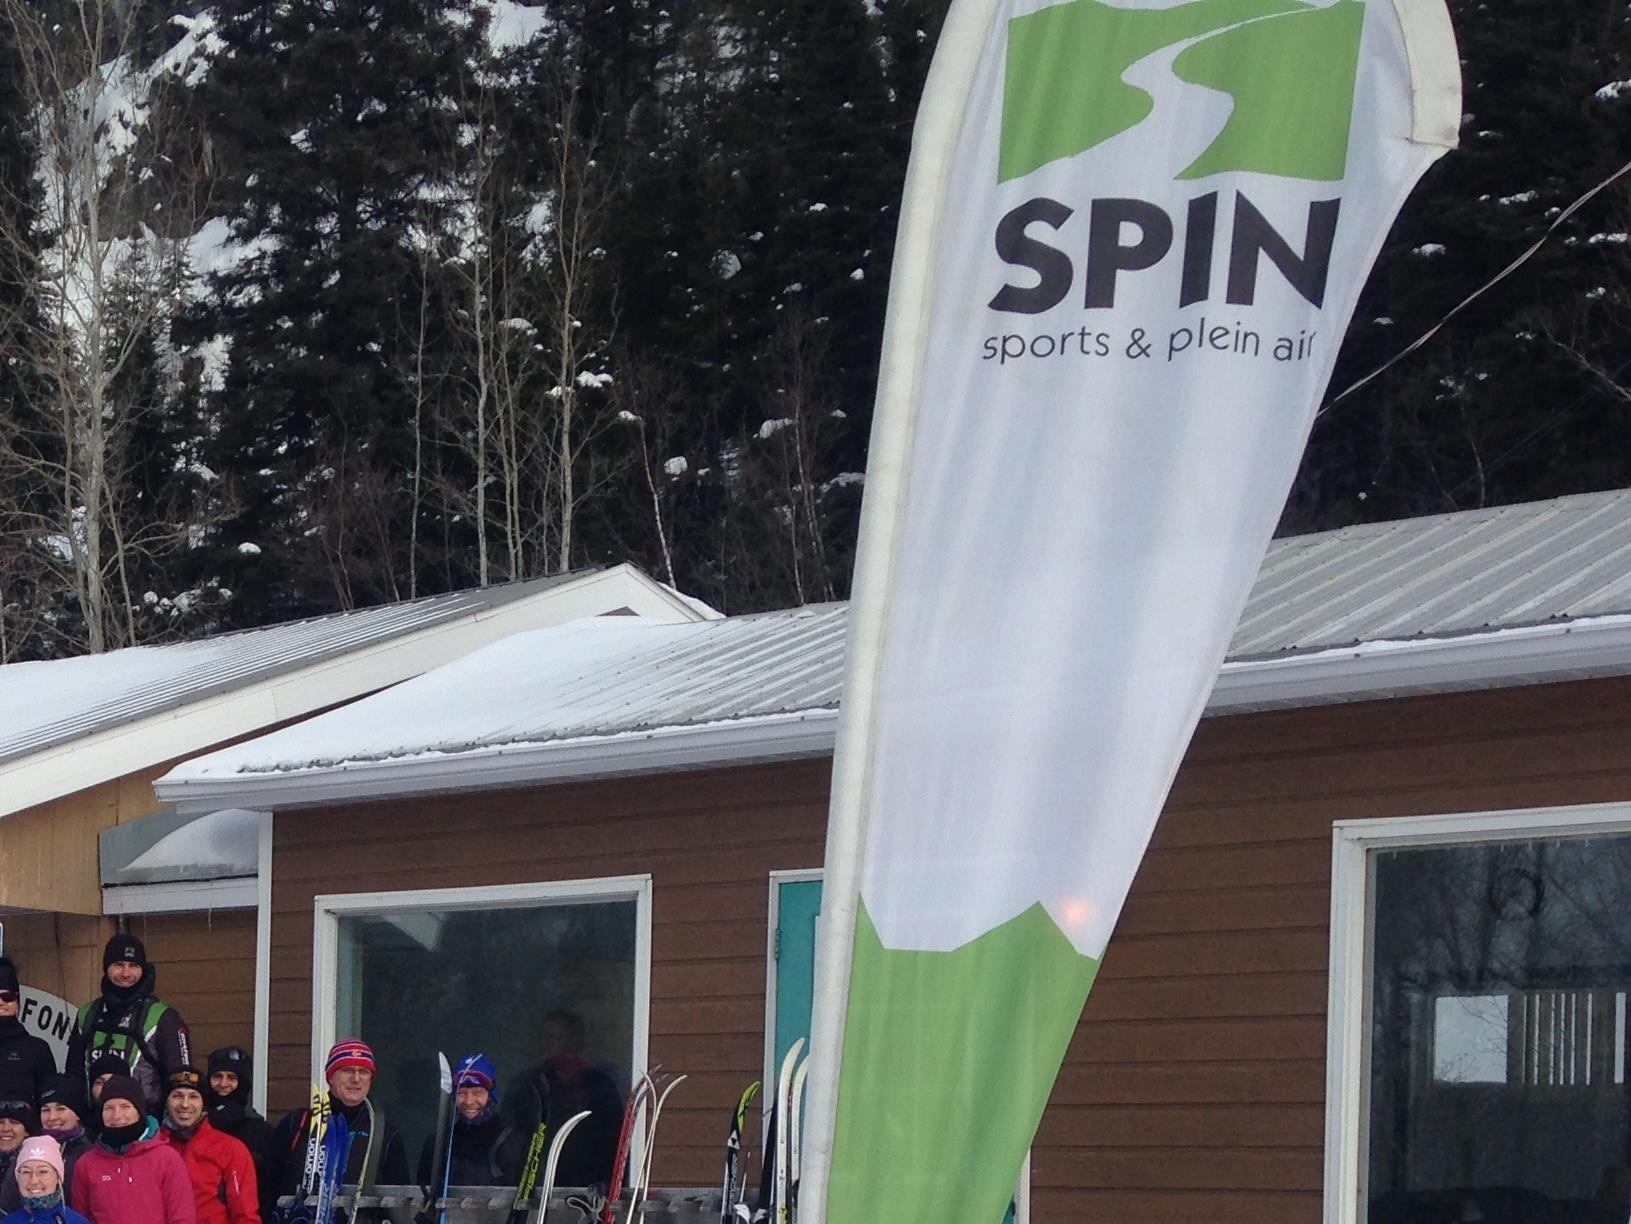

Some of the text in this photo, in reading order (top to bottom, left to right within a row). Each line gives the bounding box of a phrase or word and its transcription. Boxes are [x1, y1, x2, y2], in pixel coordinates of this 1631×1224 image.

[988, 190, 1342, 314] SPIN
[982, 317, 1317, 364] sports & plein air
